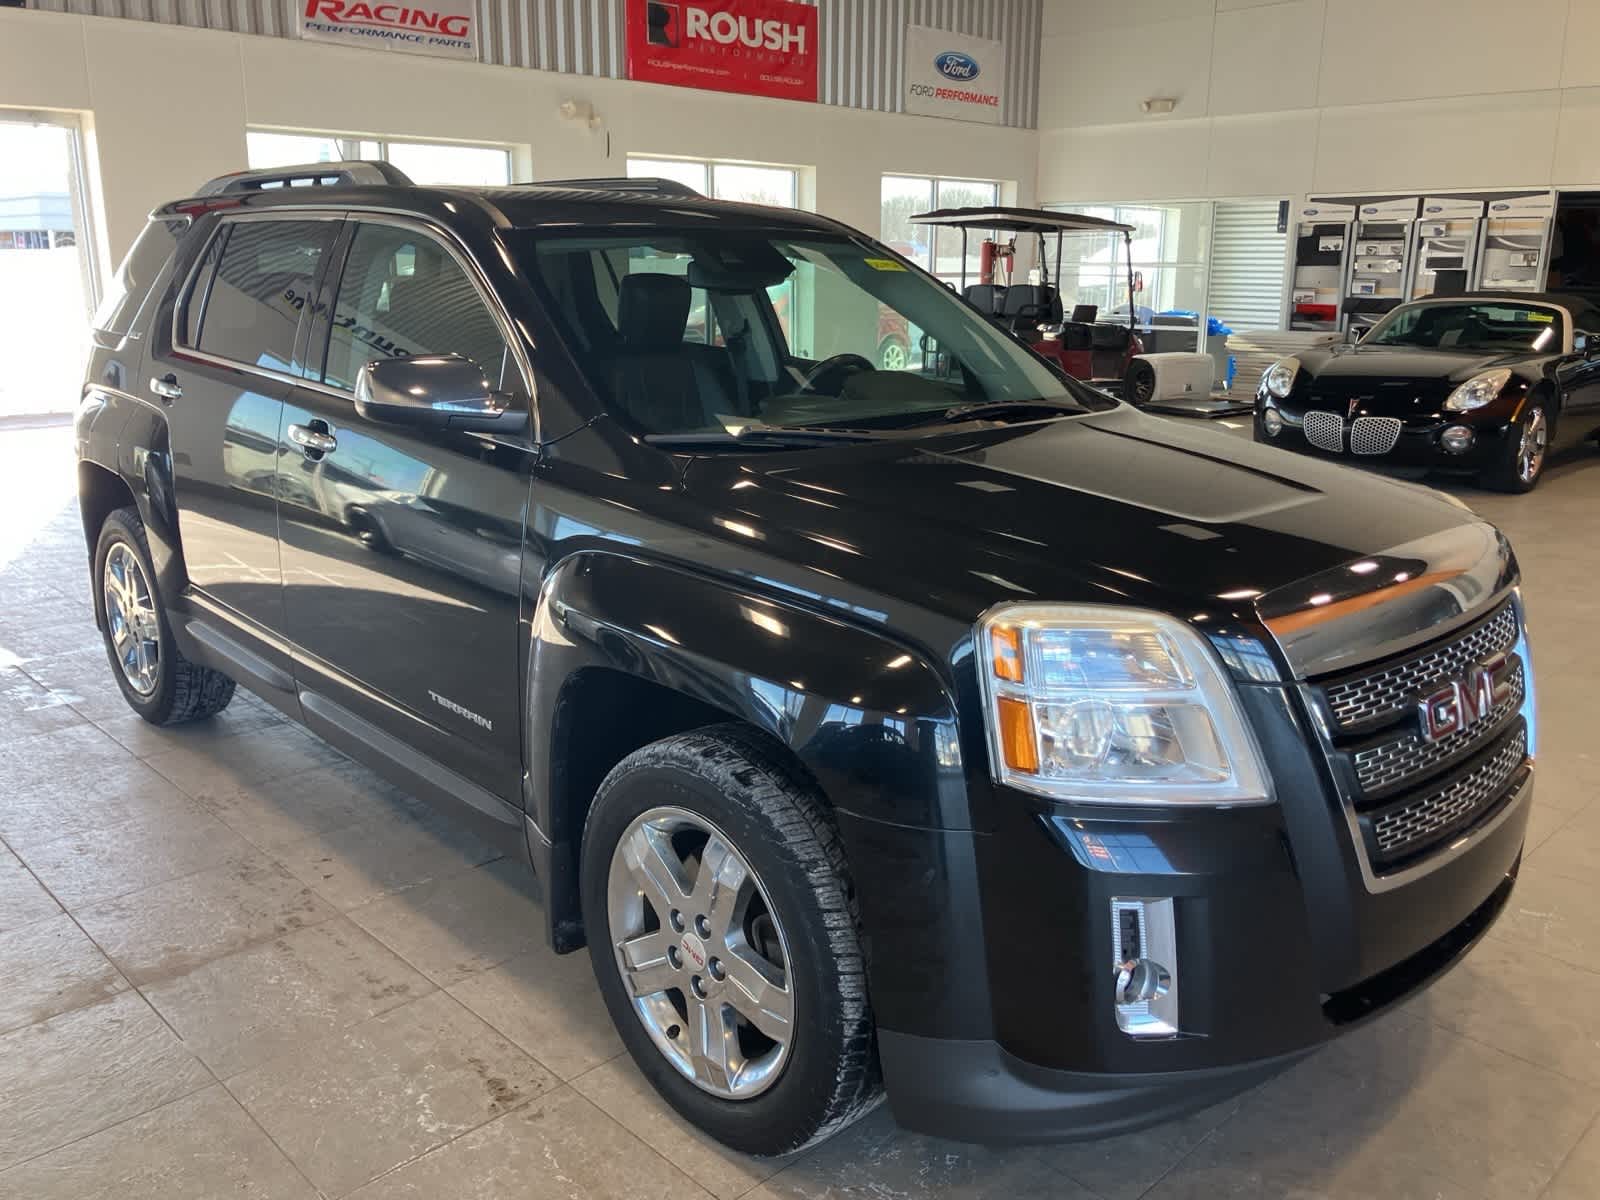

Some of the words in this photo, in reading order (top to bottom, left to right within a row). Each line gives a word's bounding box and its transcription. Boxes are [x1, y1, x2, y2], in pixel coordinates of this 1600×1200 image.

[305, 0, 470, 37] RACING
[305, 21, 424, 43] PERFORMANCE
[428, 36, 472, 49] PARTS
[686, 7, 806, 54] ROUSH
[942, 55, 972, 77] Ford
[910, 84, 935, 97] FORD
[935, 88, 999, 107] PERFORMANCE
[427, 689, 492, 731] TERRAIN
[1418, 652, 1512, 742] GMC
